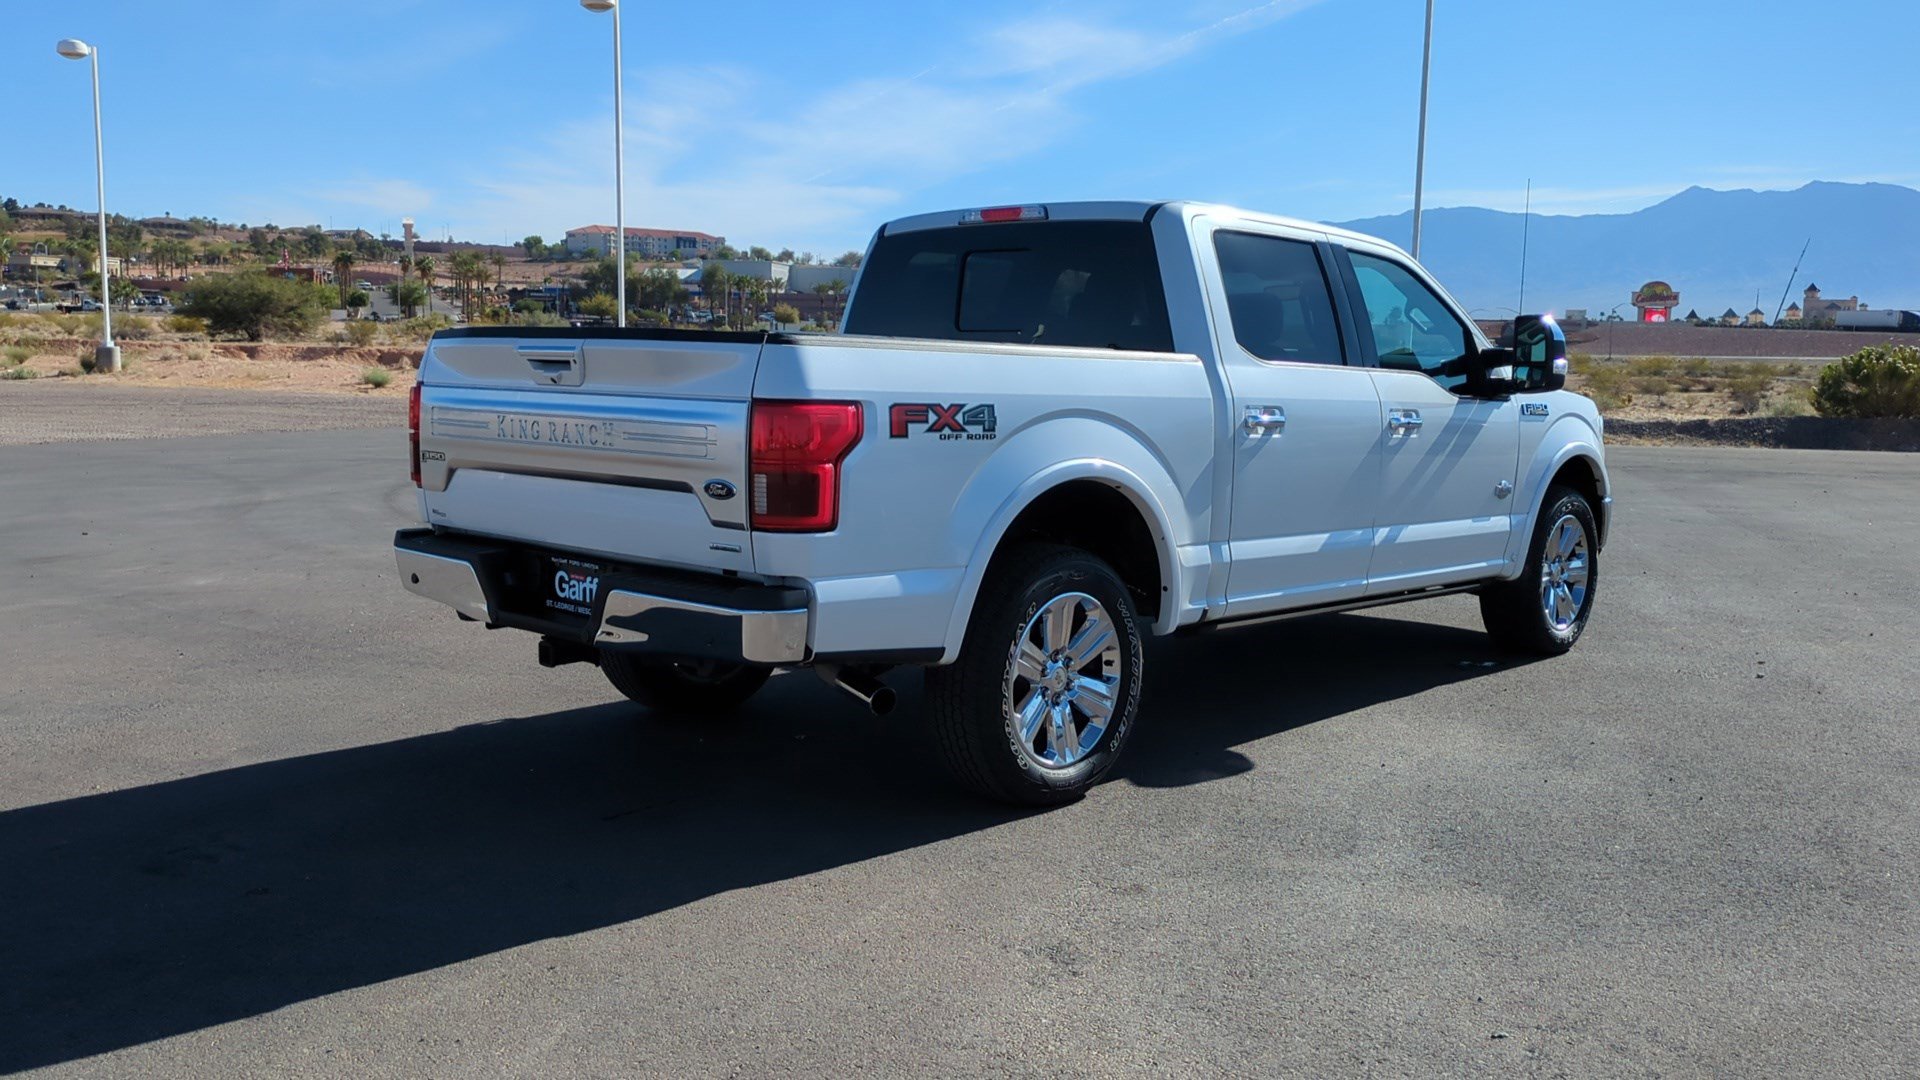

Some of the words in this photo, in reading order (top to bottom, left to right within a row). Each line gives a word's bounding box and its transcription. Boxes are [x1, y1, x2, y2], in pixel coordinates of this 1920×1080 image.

[497, 415, 540, 440] KING
[548, 421, 614, 447] RANCH
[889, 403, 997, 438] FX4
[966, 433, 996, 441] ROAD
[555, 570, 599, 603] Garff
[1110, 598, 1139, 752] WRANGLER
